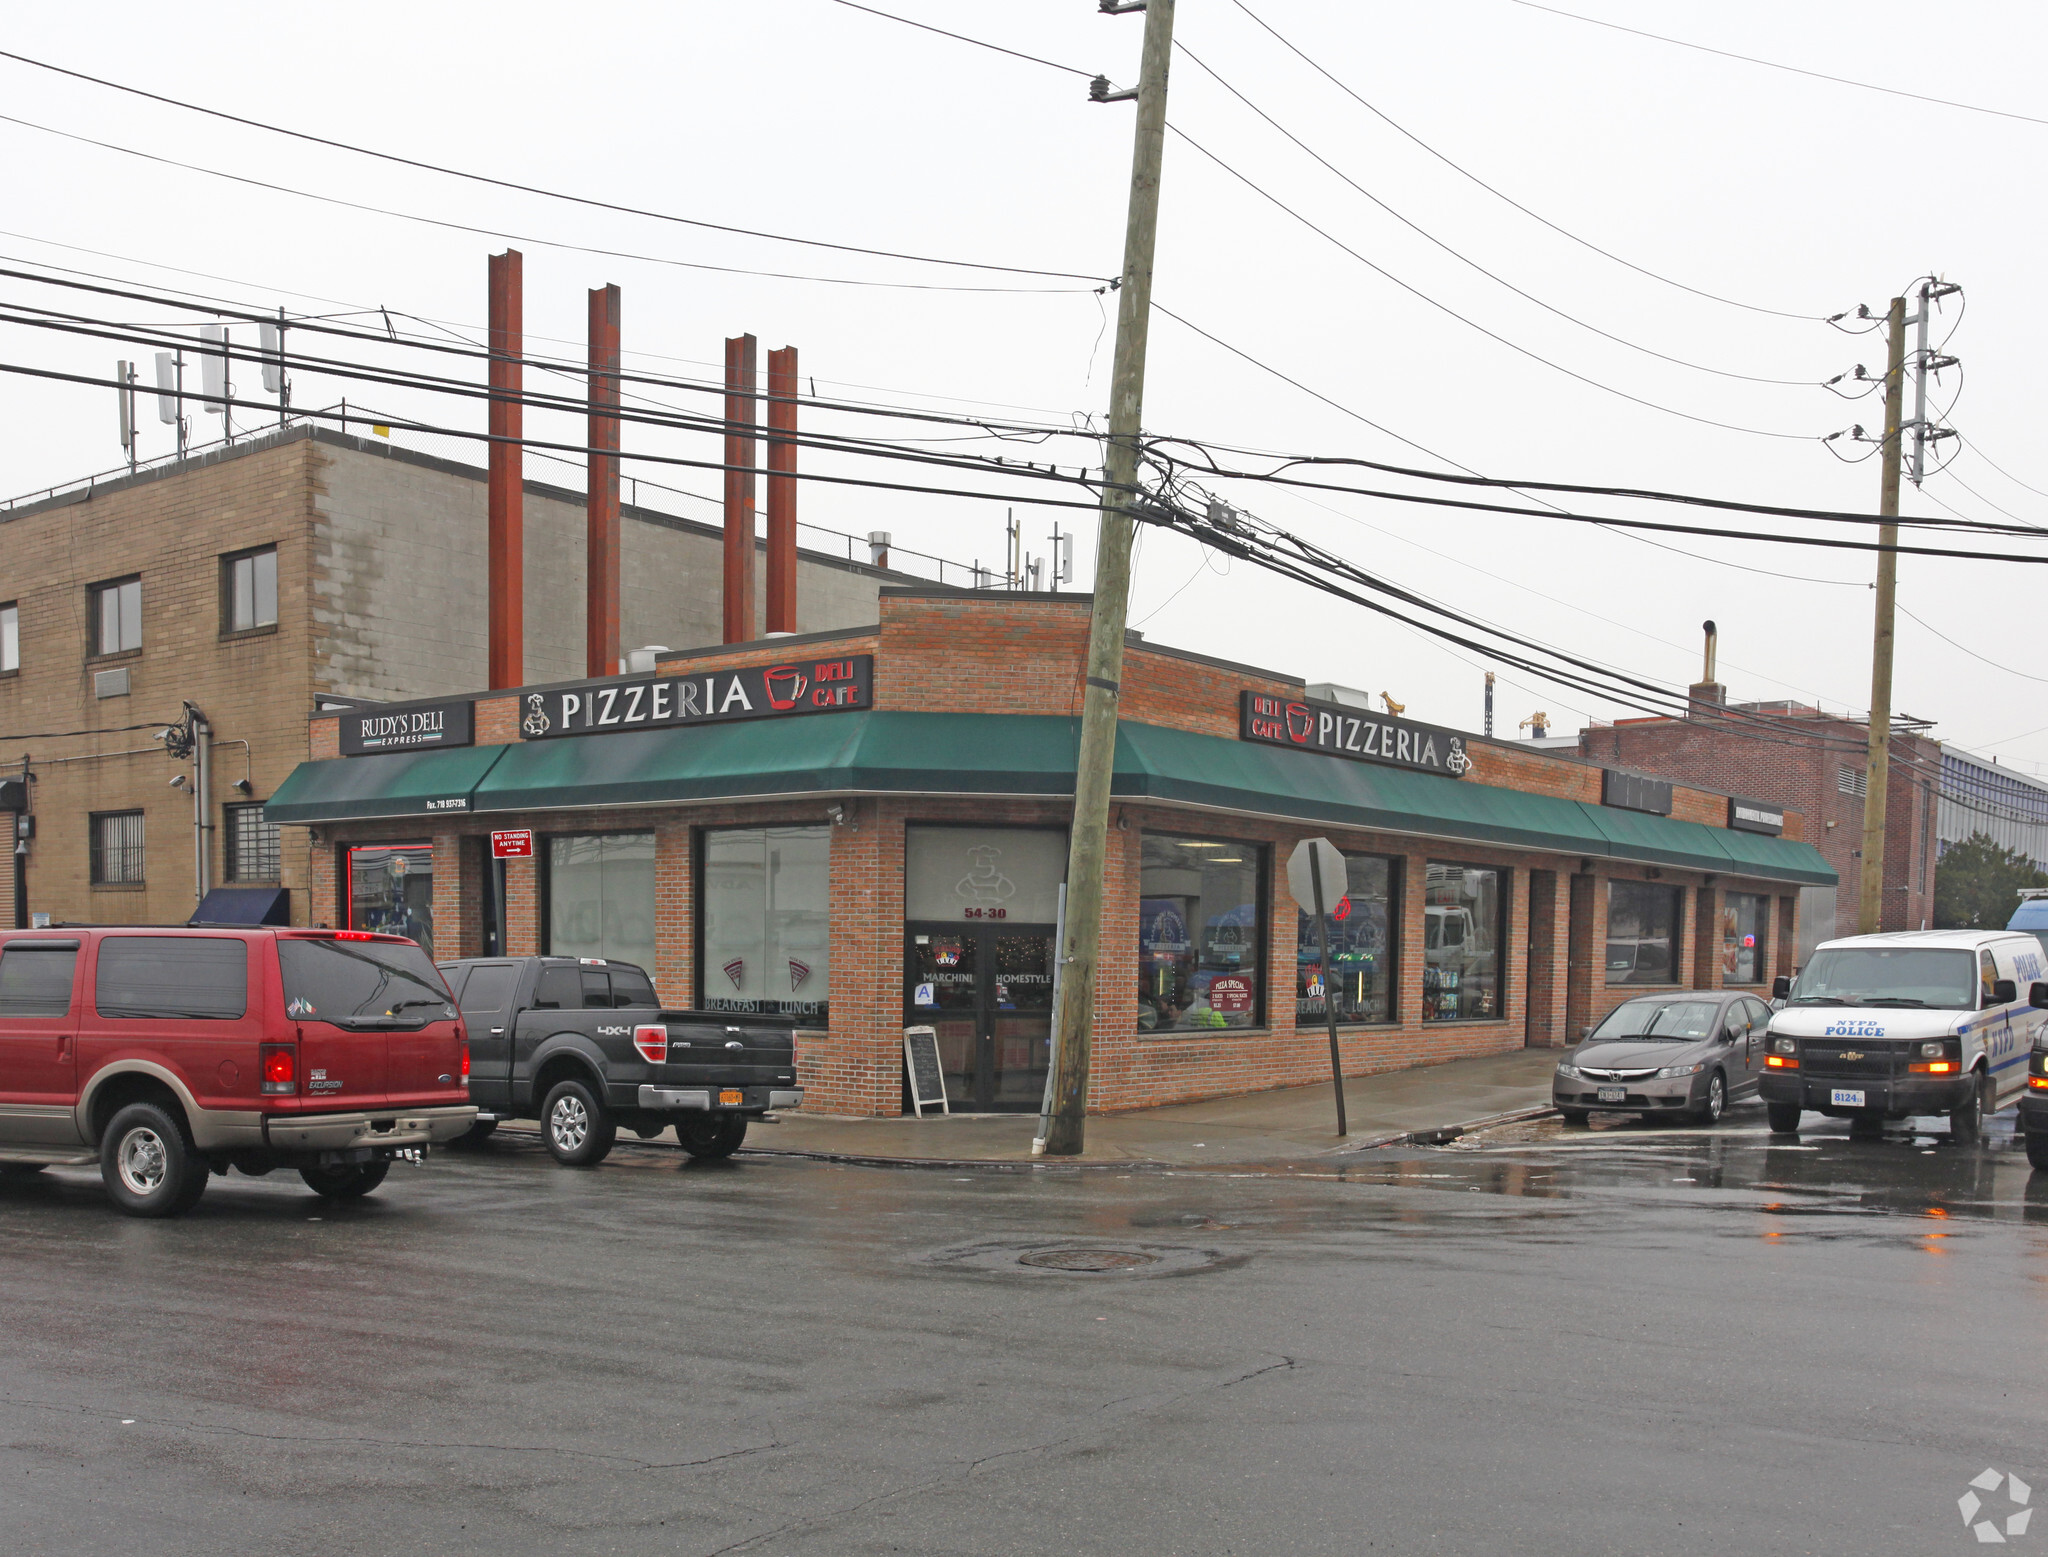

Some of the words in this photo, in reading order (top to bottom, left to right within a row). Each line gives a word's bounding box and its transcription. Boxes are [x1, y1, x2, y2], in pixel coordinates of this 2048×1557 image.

[815, 661, 853, 682] DELI
[562, 675, 753, 729] PIZZERIA
[812, 685, 858, 707] CAFE
[1254, 697, 1280, 717] DELI
[361, 713, 408, 737] RUDY'S
[411, 711, 444, 732] DELI
[1252, 719, 1283, 740] CAFE
[382, 734, 422, 746] EXPRESS
[1318, 712, 1439, 767] PIZZERIA
[499, 839, 525, 847] ANYTIME
[504, 832, 529, 840] STANDING
[964, 907, 1007, 919] 54-30
[2013, 953, 2042, 983] POLICE
[923, 973, 973, 983] MARCHINI
[995, 974, 1051, 984] HOMESTYLE
[1215, 981, 1228, 990] PIZZA
[1228, 979, 1245, 990] SPECIAL
[918, 985, 930, 998] A
[704, 998, 760, 1012] BREAKFAST
[779, 1000, 818, 1015] LUNCH
[1825, 1027, 1885, 1037] POLICE
[1991, 1024, 2015, 1058] NYPD
[308, 1080, 344, 1090] EXCURSION
[1834, 1093, 1857, 1103] 8124
